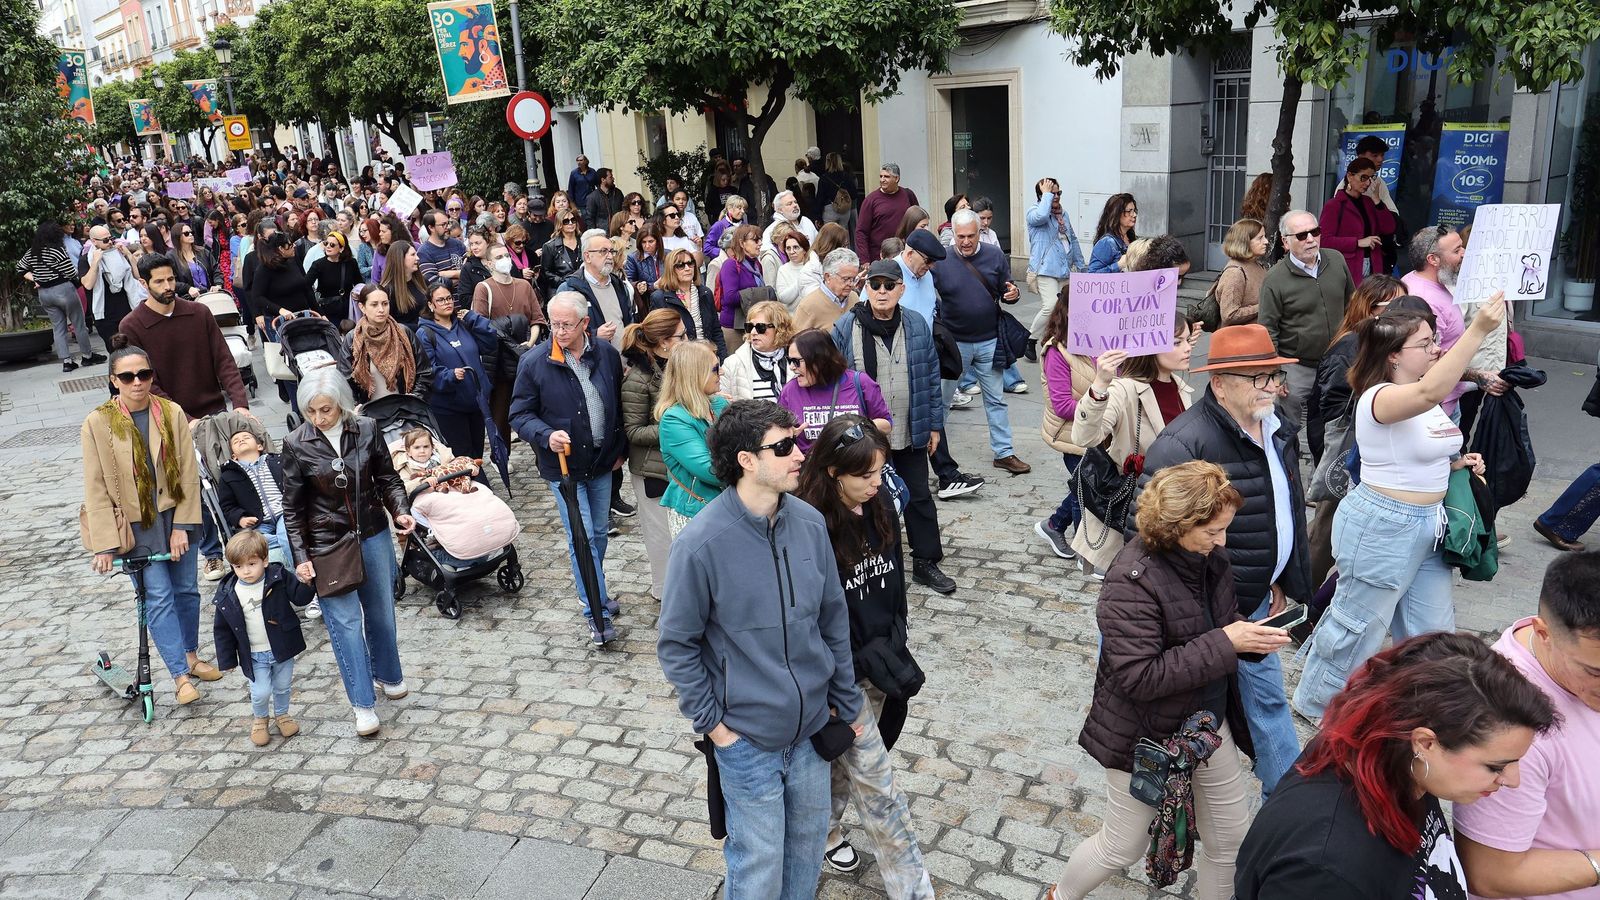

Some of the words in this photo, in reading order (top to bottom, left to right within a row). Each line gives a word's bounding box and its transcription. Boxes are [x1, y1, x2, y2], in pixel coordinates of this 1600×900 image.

[433, 12, 455, 28] 30
[66, 53, 84, 68] 30
[205, 83, 216, 92] 30
[1380, 138, 1400, 146] IGI
[1464, 133, 1494, 143] DIGI
[415, 156, 438, 167] STOP
[1454, 155, 1498, 166] 500Mb
[1460, 174, 1485, 186] 10€
[1502, 206, 1548, 228] PERRO
[1076, 280, 1116, 294] SOMOS
[1121, 280, 1130, 293] EL
[1092, 292, 1160, 314] CORAZÓN
[1119, 316, 1128, 330] DE
[1132, 314, 1148, 329] LAS
[1150, 312, 1167, 327] QUE
[1074, 332, 1093, 348] YA
[1100, 336, 1119, 350] NO
[1123, 329, 1168, 349] ESTÁN
